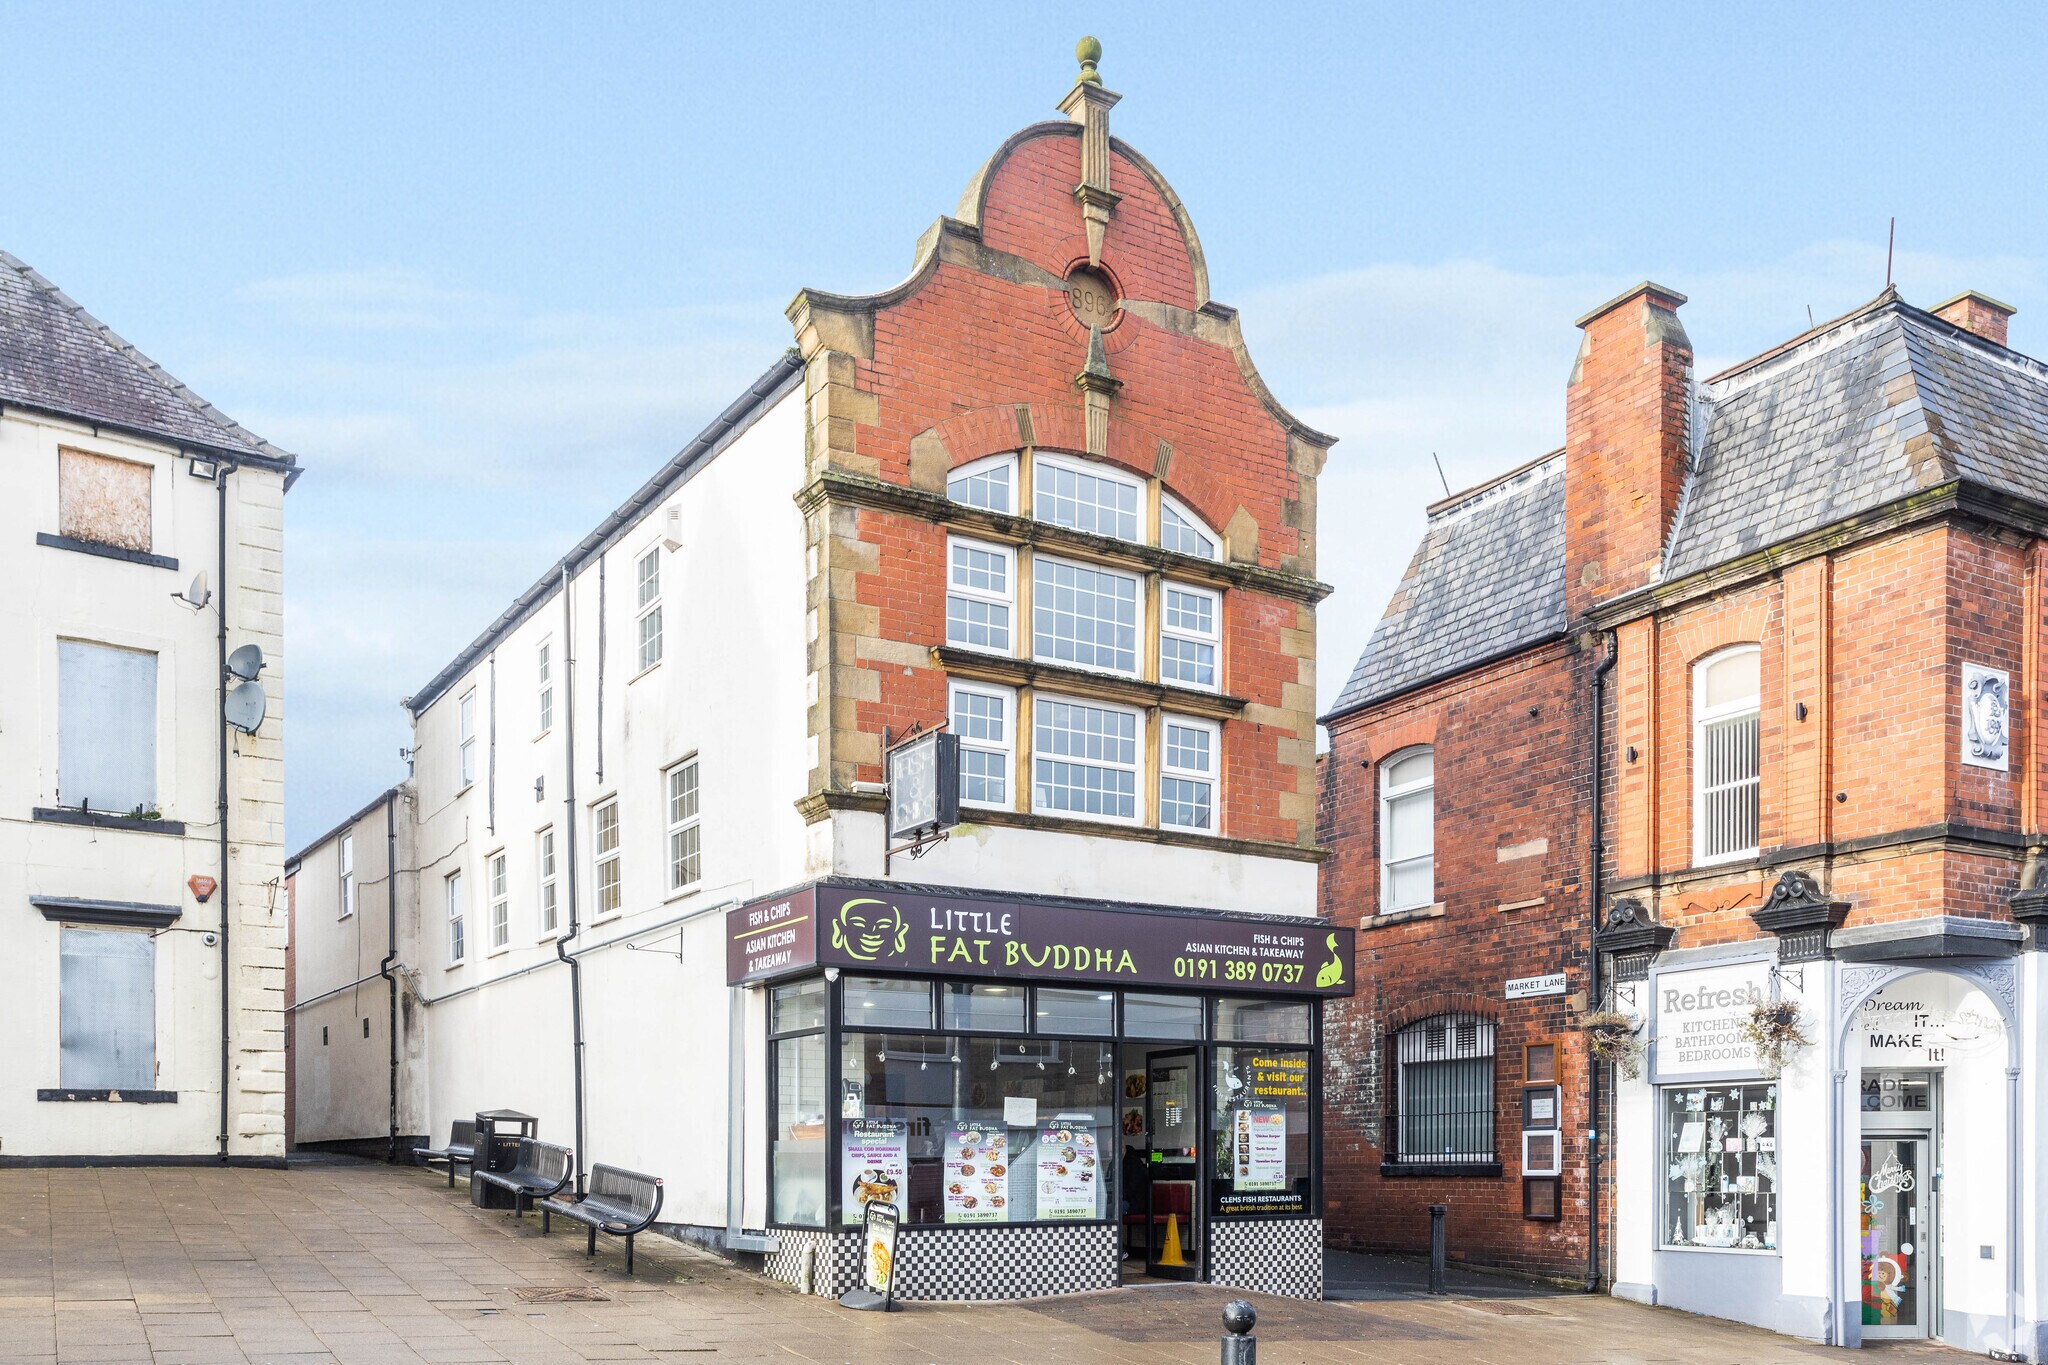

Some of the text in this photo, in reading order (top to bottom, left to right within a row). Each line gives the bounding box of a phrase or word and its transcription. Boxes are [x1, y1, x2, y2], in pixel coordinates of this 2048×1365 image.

[1072, 287, 1106, 317] 896
[749, 901, 791, 927] FISH & CHIPS
[930, 907, 1012, 935] LITTLE
[745, 929, 796, 955] ASIAN KITCHEN
[1253, 934, 1304, 947] FISH & CHIPS
[930, 935, 1138, 974] FAT BUDDHA
[1185, 942, 1304, 959] ASIAN KITCHEN & TAKEAWAY
[749, 950, 792, 973] & TAKEAWAY
[1174, 957, 1304, 983] 0191 389 0737
[1508, 977, 1565, 991] MARKET LANE
[1663, 980, 1764, 1014] Refresh
[1864, 999, 1924, 1011] Dream
[1682, 1017, 1748, 1034] KITCHENS
[1870, 1034, 1923, 1048] MAKE
[1678, 1047, 1751, 1062] BEDROOMS
[1928, 1048, 1945, 1061] It!
[1252, 1057, 1307, 1069] Come inside
[1257, 1071, 1305, 1083] & visit our
[1861, 1079, 1910, 1092] RADE
[1252, 1115, 1270, 1124] NEW
[854, 1130, 895, 1138] Restaurant
[861, 1137, 887, 1146] special
[1257, 1195, 1302, 1203] RESTAURANTS
[1225, 1205, 1240, 1213] great
[1240, 1204, 1256, 1212] british
